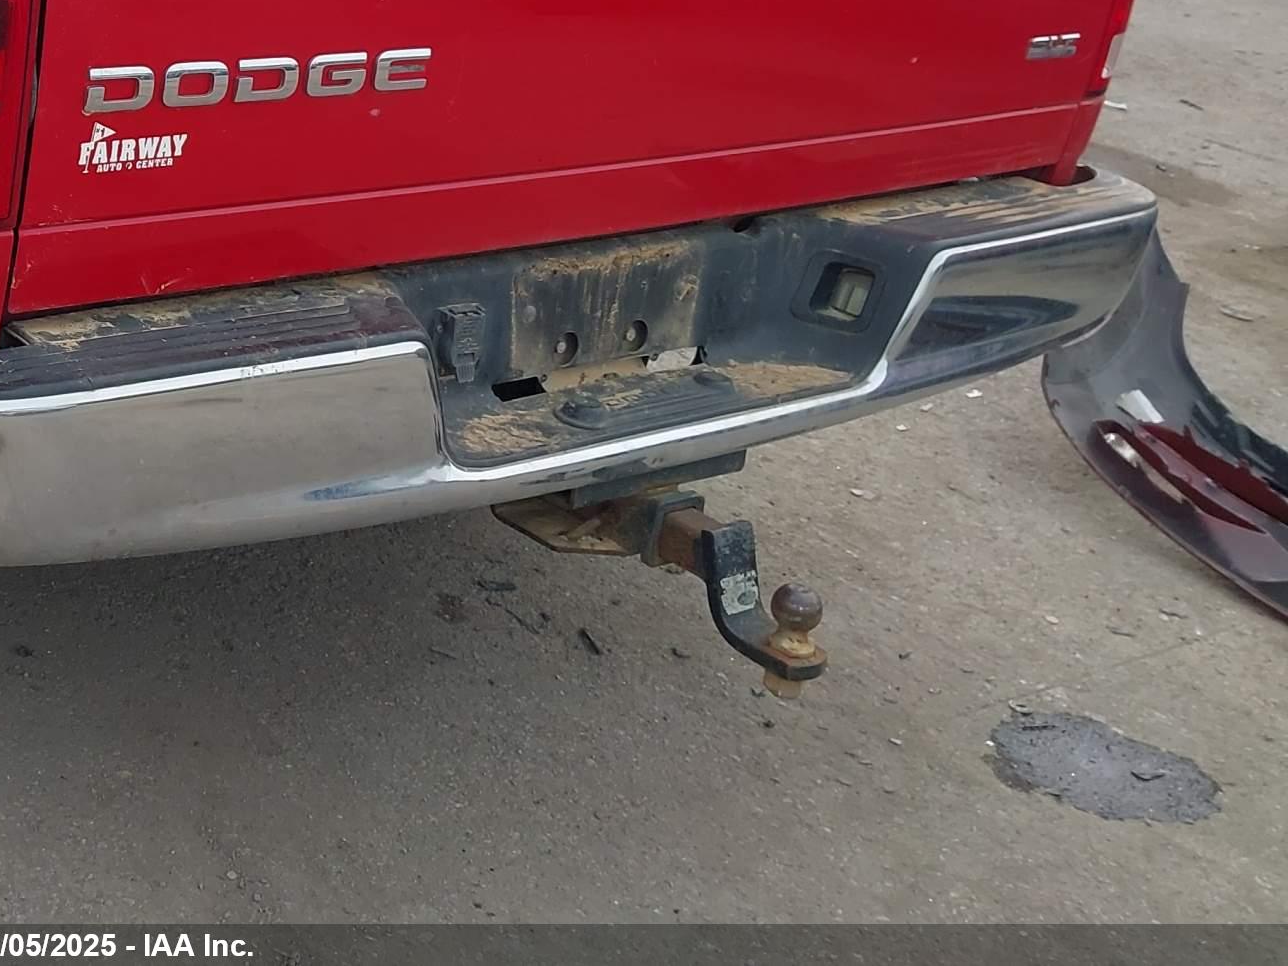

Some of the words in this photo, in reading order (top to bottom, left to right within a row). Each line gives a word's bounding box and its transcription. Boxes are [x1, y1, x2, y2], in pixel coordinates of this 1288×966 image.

[83, 47, 432, 115] DODGE
[78, 133, 188, 167] FAIRWAY
[96, 162, 123, 173] AUTO
[135, 157, 174, 170] CENTER
